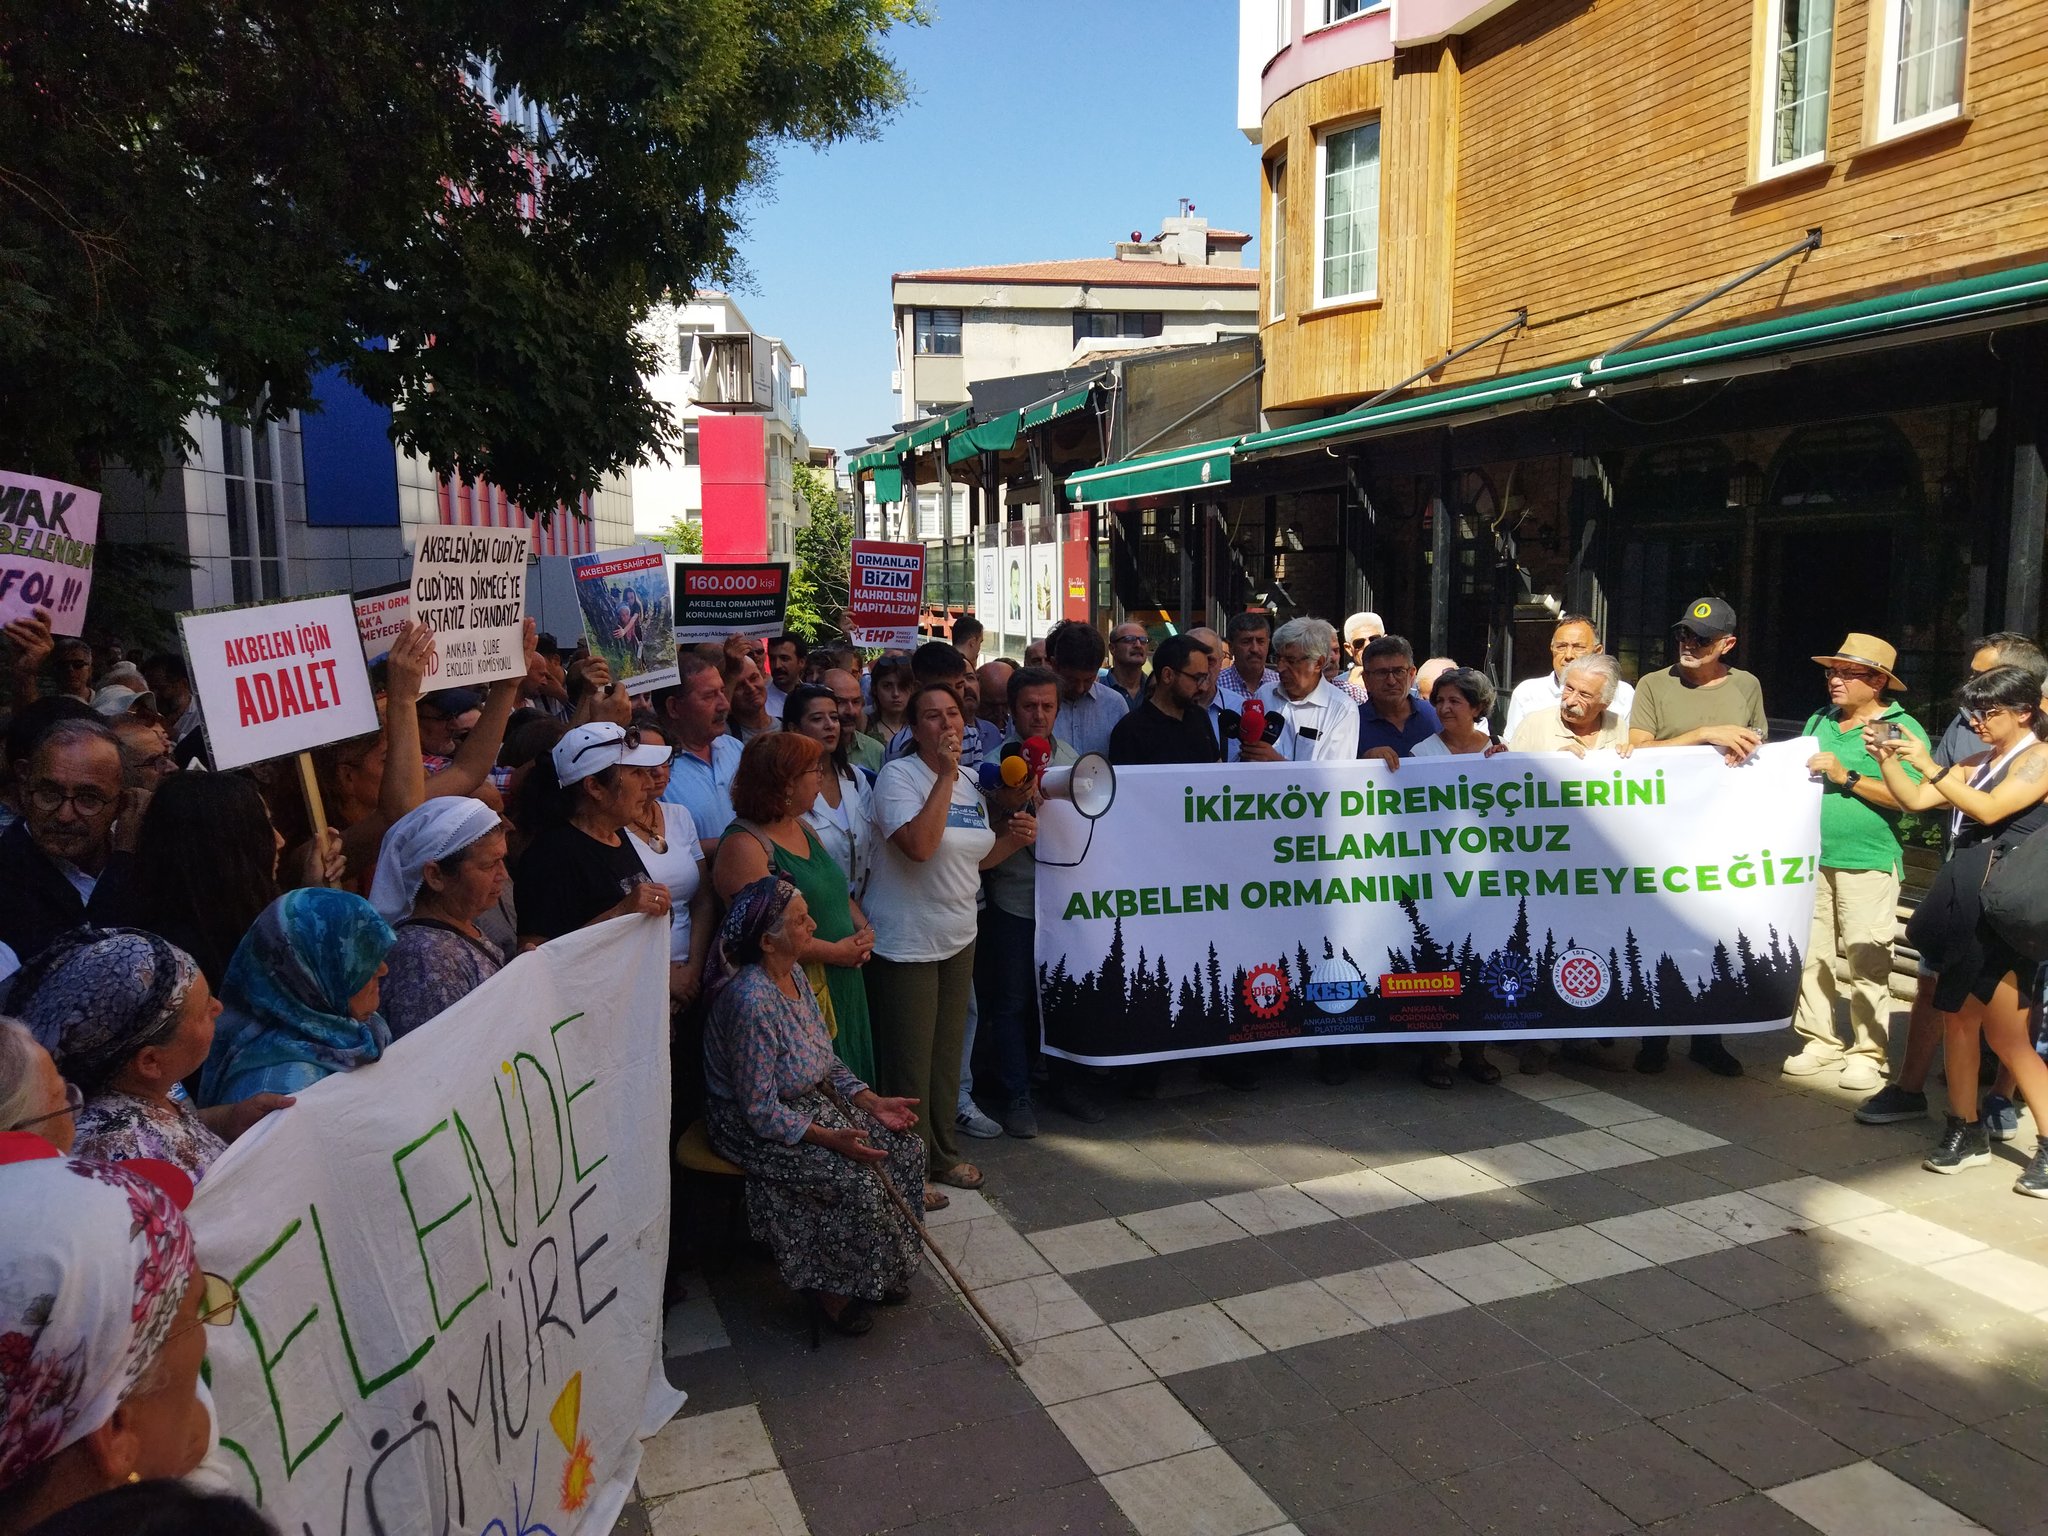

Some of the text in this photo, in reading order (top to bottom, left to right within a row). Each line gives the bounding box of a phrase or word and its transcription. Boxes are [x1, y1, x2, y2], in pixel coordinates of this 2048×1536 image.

[420, 531, 527, 564] AKBELEN'DEN CUDİ'YE
[580, 556, 660, 578] AKBELEN'E SAHİP ÇIK!
[857, 554, 919, 569] ORMANLAR
[416, 570, 520, 602] CUDİ'DEN DİKMECE'YE
[689, 576, 775, 590] 160.000 kişi
[864, 570, 910, 587] BİZİM
[0, 568, 54, 609] FOL
[854, 589, 918, 603] KAHROLSUN
[388, 595, 409, 609] ORM
[689, 599, 775, 608] AKBELEN ORMANI'NIN
[853, 602, 916, 615] KAPİTALİZM
[417, 603, 520, 633] YASTAYIZ İSYANDAYIZ
[686, 609, 776, 619] KORUNMASINI İSTİYOR!
[224, 621, 331, 667] AKBELEN İÇİN
[865, 630, 895, 642] EHP
[446, 641, 477, 658] ANKARA
[478, 656, 511, 674] KOMİSYONU
[235, 659, 342, 728] ADALET
[1184, 769, 1666, 823] İKİZKÖY DİRENİŞÇİLERİNİ
[1273, 825, 1571, 865] SELAMLIYORUZ
[1062, 849, 1816, 921] AKBELEN ORMANINI VERMEYECEĞİZ!
[1387, 974, 1455, 991] tmmob
[1554, 963, 1564, 993] ANKARA
[1306, 981, 1368, 1001] KESK
[1401, 1005, 1436, 1013] ANKARA
[1484, 1012, 1519, 1020] ANKARA
[1251, 1020, 1287, 1031] ANADOLU
[1303, 1018, 1336, 1026] ANKARA
[1315, 1024, 1365, 1034] PLATFORMU
[1407, 1022, 1442, 1030] KURULU
[1502, 1021, 1527, 1029] ODASI
